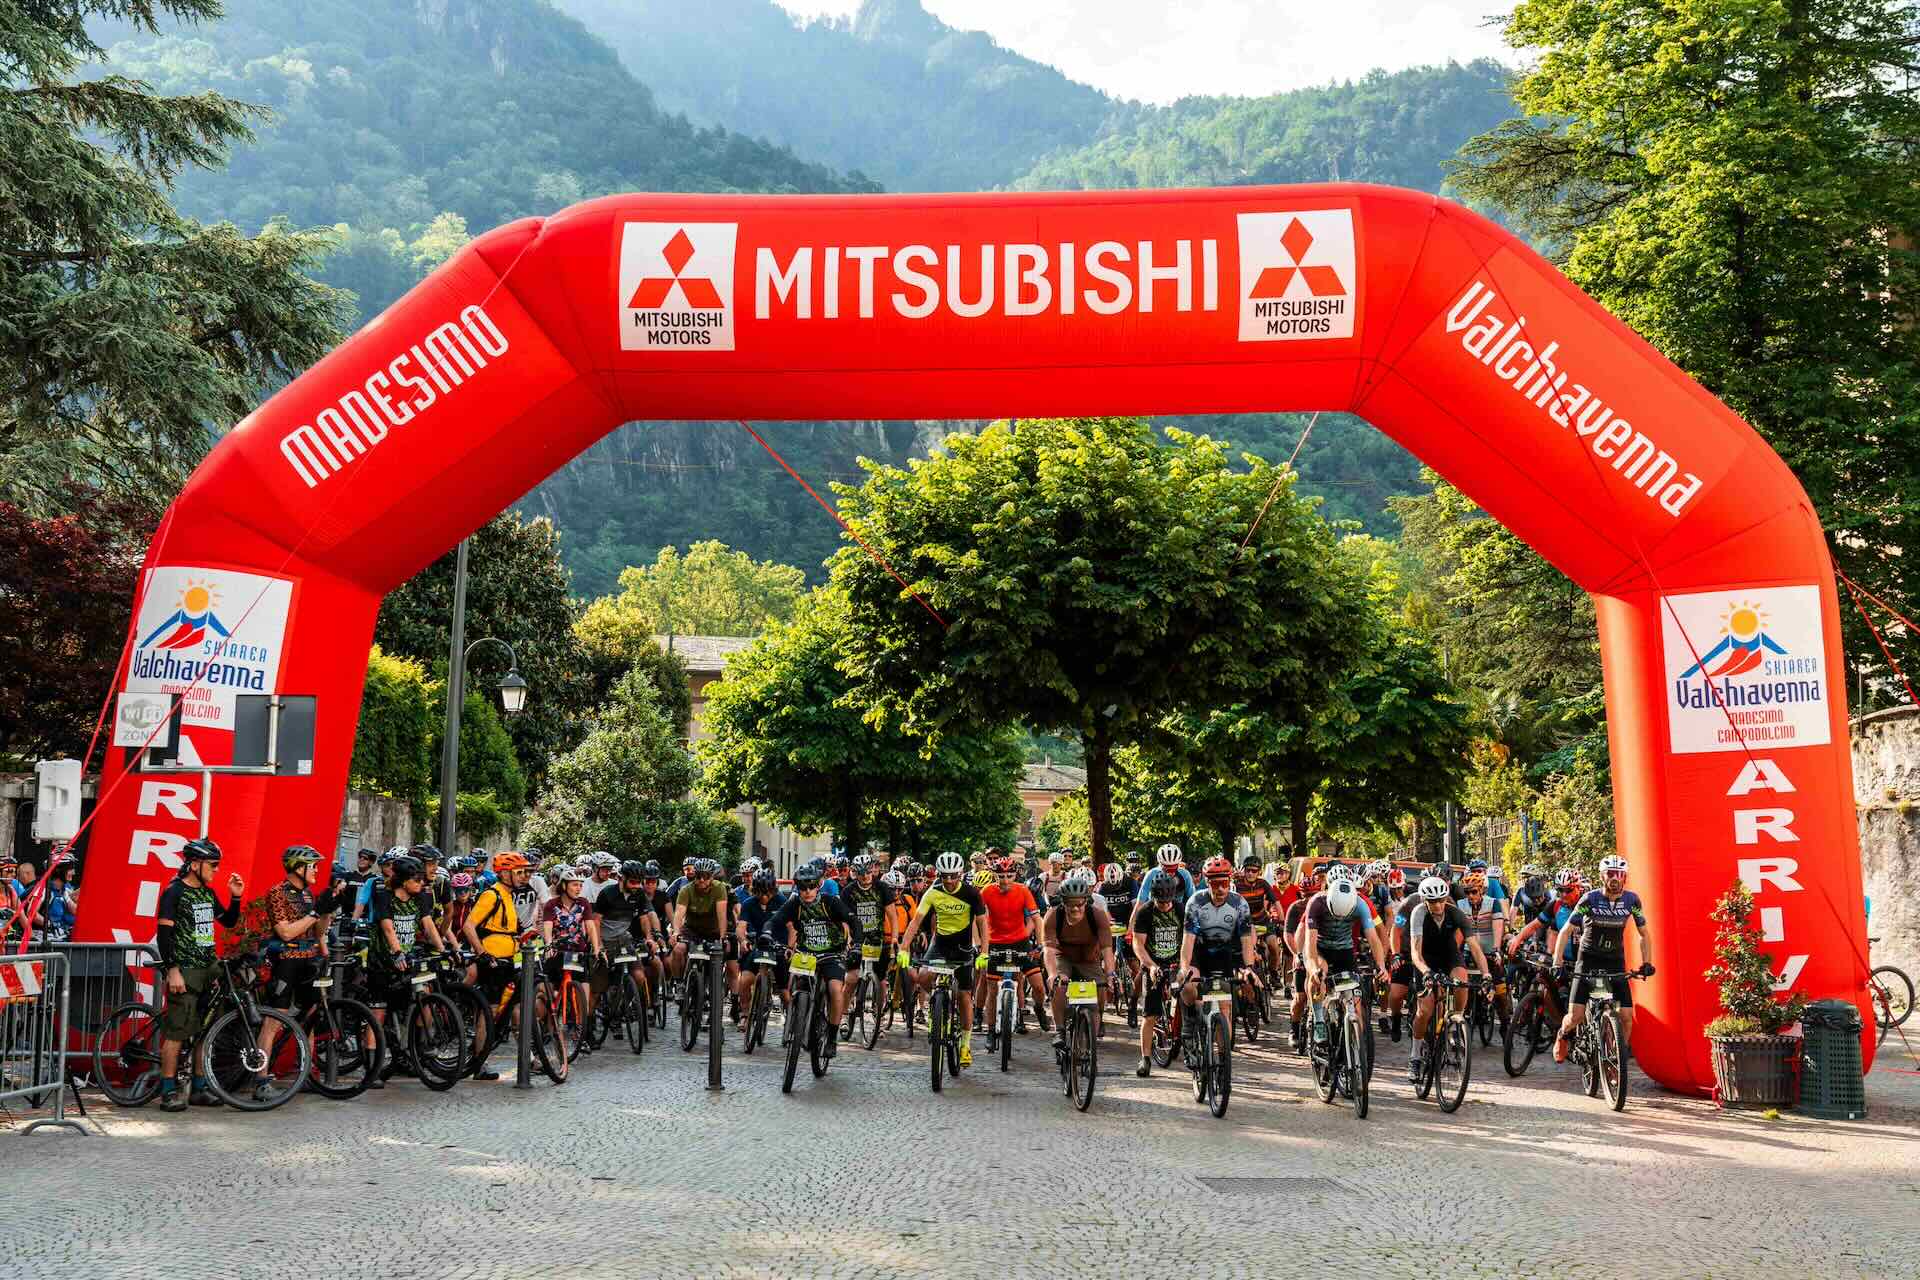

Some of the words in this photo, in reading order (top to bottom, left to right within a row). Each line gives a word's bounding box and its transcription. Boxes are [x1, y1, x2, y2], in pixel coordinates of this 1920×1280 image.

[755, 239, 1218, 319] MITSUBISHI
[1255, 299, 1344, 317] MITSUBISHI
[634, 312, 723, 328] MITSUBISHI
[1266, 318, 1330, 335] MOTORS
[647, 330, 711, 345] MOTORS
[280, 304, 509, 489] MADESIMO
[1446, 281, 1703, 517] Valchiavenna
[133, 649, 265, 691] Valchiavenna
[1764, 658, 1817, 677] SKIAREA
[1676, 677, 1821, 710] Valchiavenna
[1728, 709, 1784, 726] MADESIMO
[1717, 725, 1796, 744] CAMPODOLCINO
